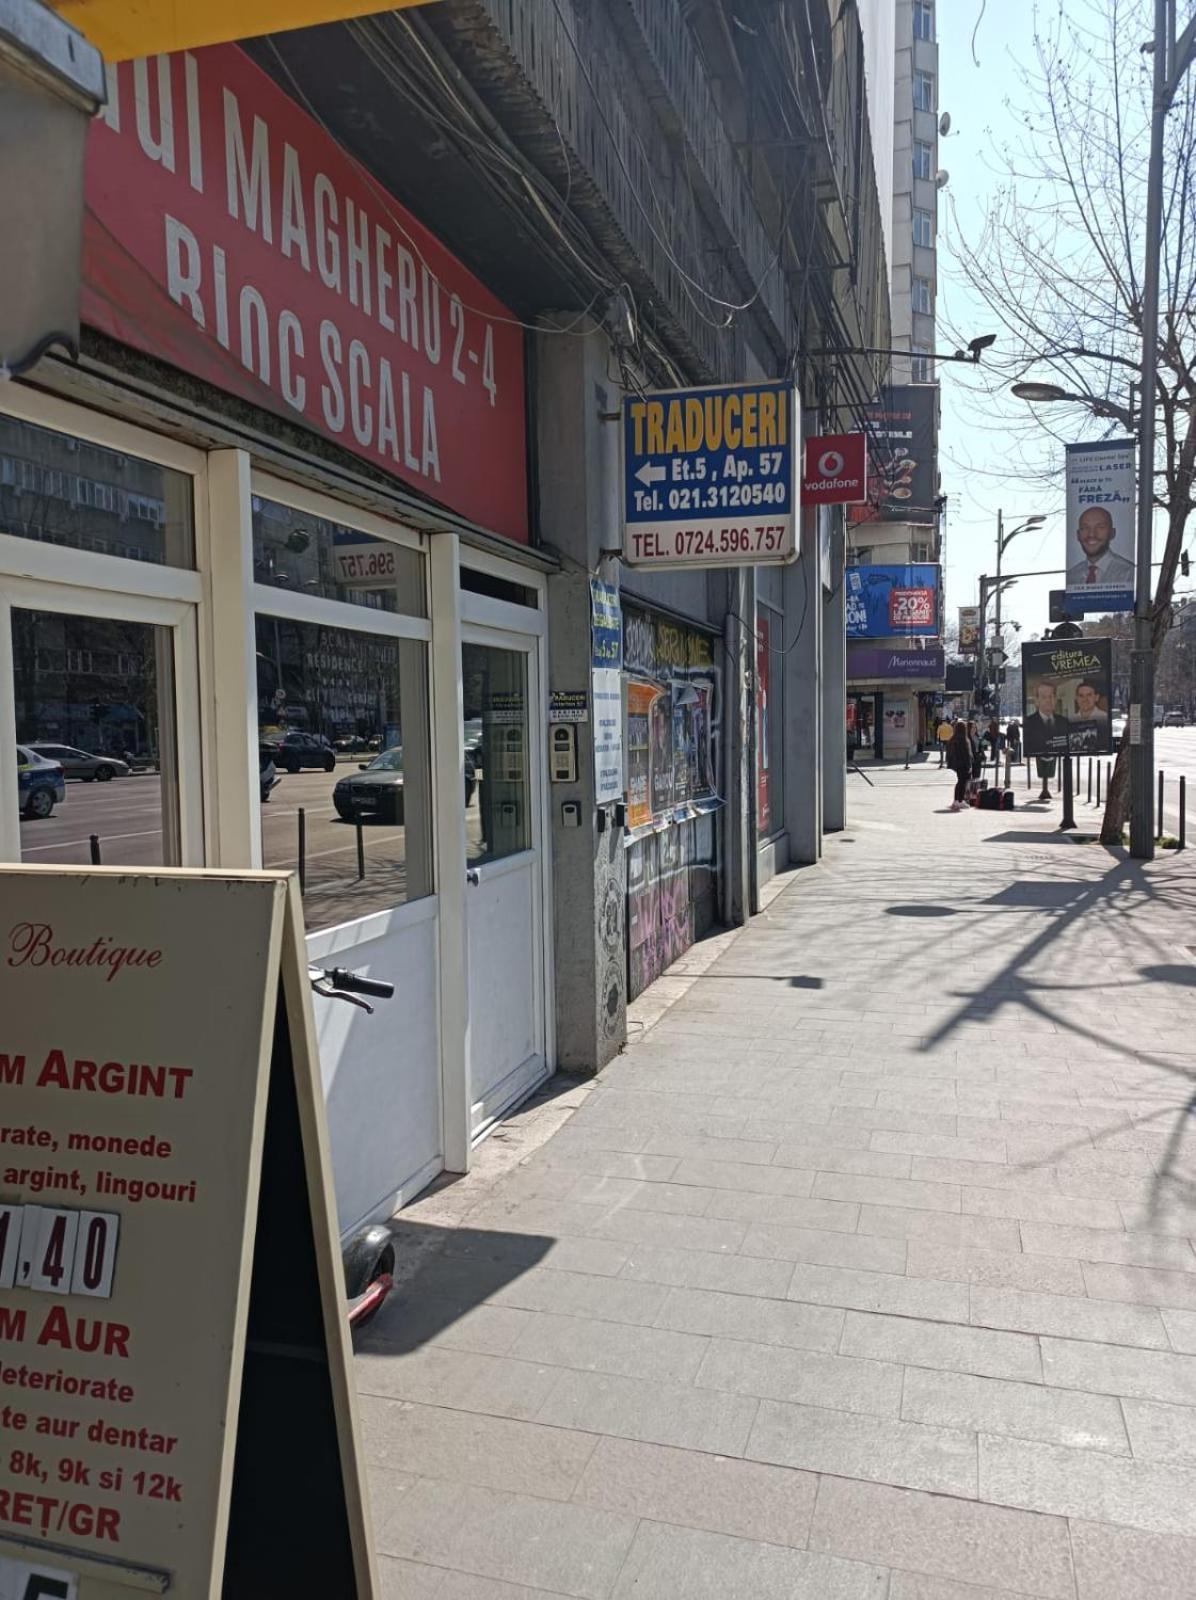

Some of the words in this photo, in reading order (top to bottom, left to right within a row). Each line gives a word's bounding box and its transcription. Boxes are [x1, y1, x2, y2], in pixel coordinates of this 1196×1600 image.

[223, 86, 442, 365] MAGHERU
[450, 293, 497, 408] 2-4
[319, 319, 442, 483] SCALA
[631, 390, 787, 455] TRADUCERI
[723, 454, 753, 482] Ap.
[760, 452, 783, 475] 57
[804, 478, 858, 491] vodafone
[1099, 463, 1131, 472] LASER
[634, 490, 664, 512] Tel.
[669, 482, 786, 510] 021.3120540
[632, 533, 669, 557] TEL.
[675, 526, 785, 555] 0724.596.757
[893, 597, 930, 611] -20%
[1051, 649, 1082, 662] editura
[1051, 655, 1102, 671] VREMEA
[7, 922, 163, 982] Boutique
[36, 1048, 193, 1099] ARGINT
[1, 1125, 58, 1152] rate,
[68, 1130, 172, 1158] monede
[3, 1166, 87, 1194] argint,
[96, 1171, 197, 1202] lingouri
[37, 1305, 131, 1358] AUR
[0, 1361, 134, 1402] eteriorate
[1, 1406, 28, 1430] te
[36, 1416, 80, 1438] aur
[88, 1420, 178, 1454] dentar
[9, 1450, 48, 1484] 8k,
[58, 1458, 90, 1486] 9k
[99, 1467, 123, 1491] si
[133, 1471, 183, 1502] 12k
